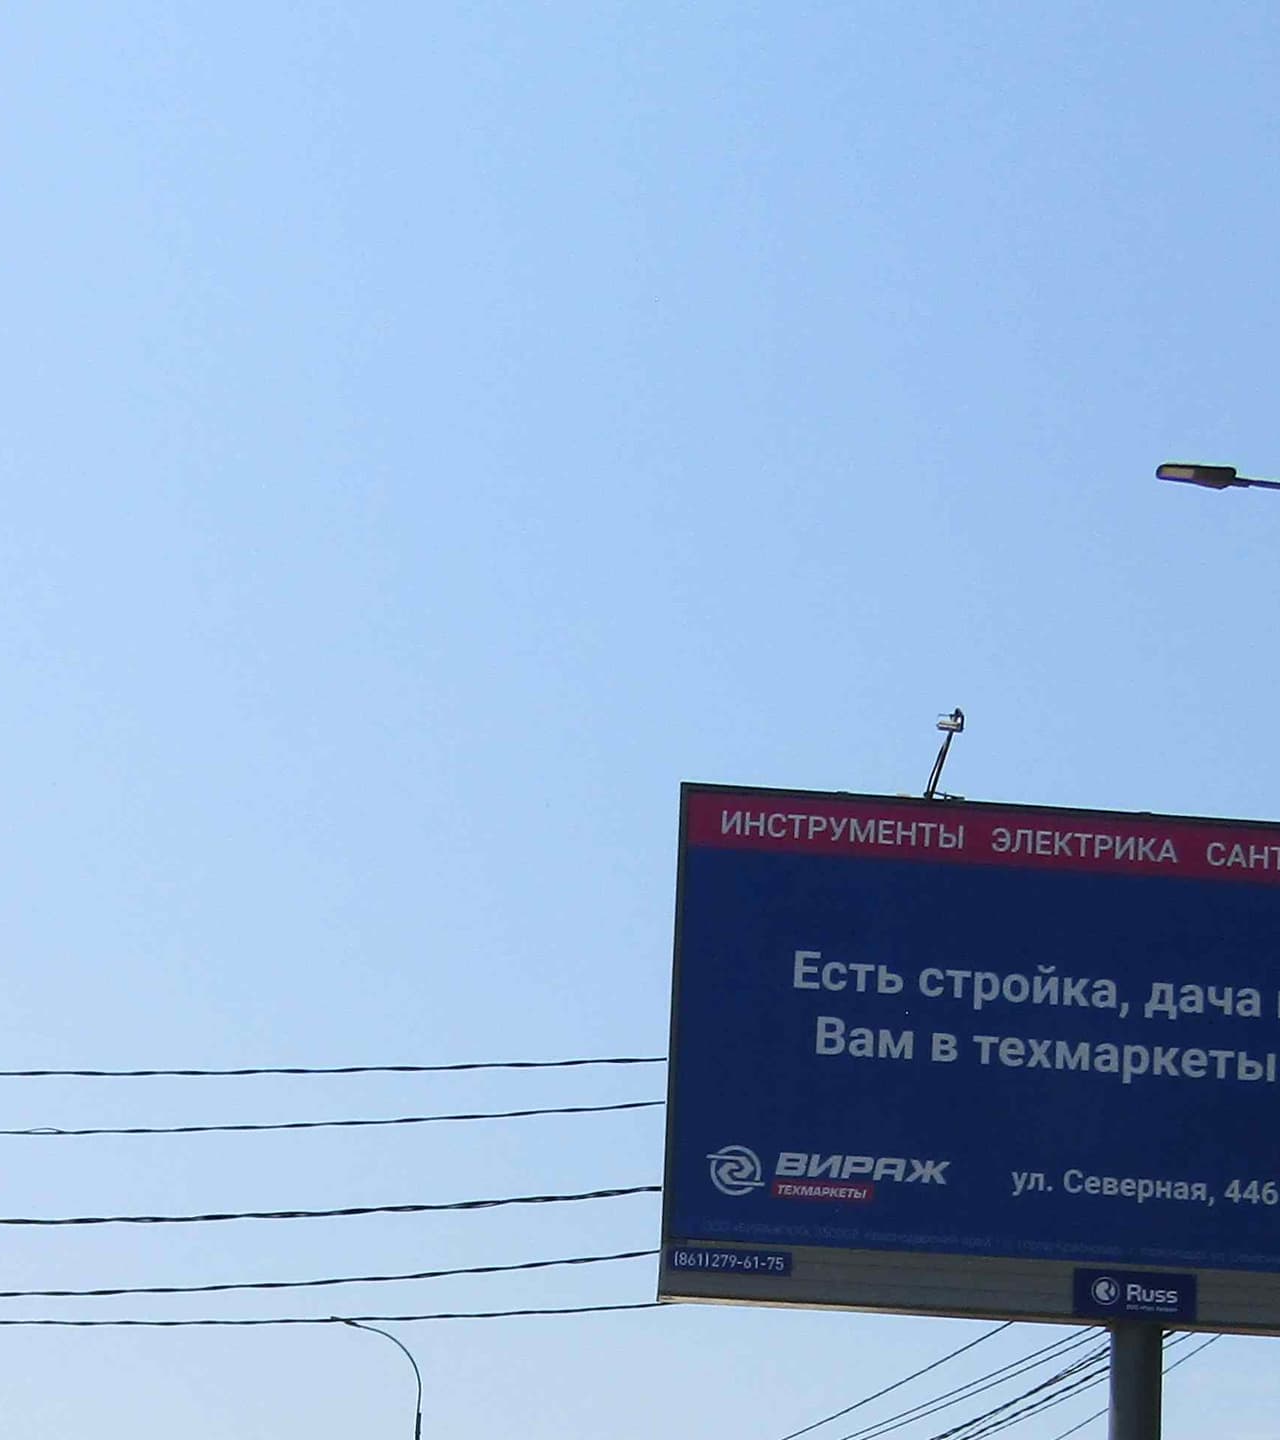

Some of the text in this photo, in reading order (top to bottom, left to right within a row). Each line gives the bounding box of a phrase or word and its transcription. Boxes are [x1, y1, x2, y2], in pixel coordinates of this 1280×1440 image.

[721, 810, 964, 849] ИНСТРУМЕНТЫ
[991, 827, 1179, 863] ЭЛЕКТРИКА
[793, 950, 904, 994] Есть
[919, 965, 1129, 1018] стройка,
[1144, 982, 1261, 1019] дача
[815, 1016, 914, 1060] Вам
[931, 1032, 958, 1062] в
[973, 1035, 1276, 1084] техмаркеты
[775, 1152, 950, 1185] ВИРАЖ
[777, 1184, 867, 1199] ТЕХМАРКЕТЫ
[1011, 1169, 1279, 1206] ул. Северная, 446
[1126, 1284, 1178, 1303] Russ
